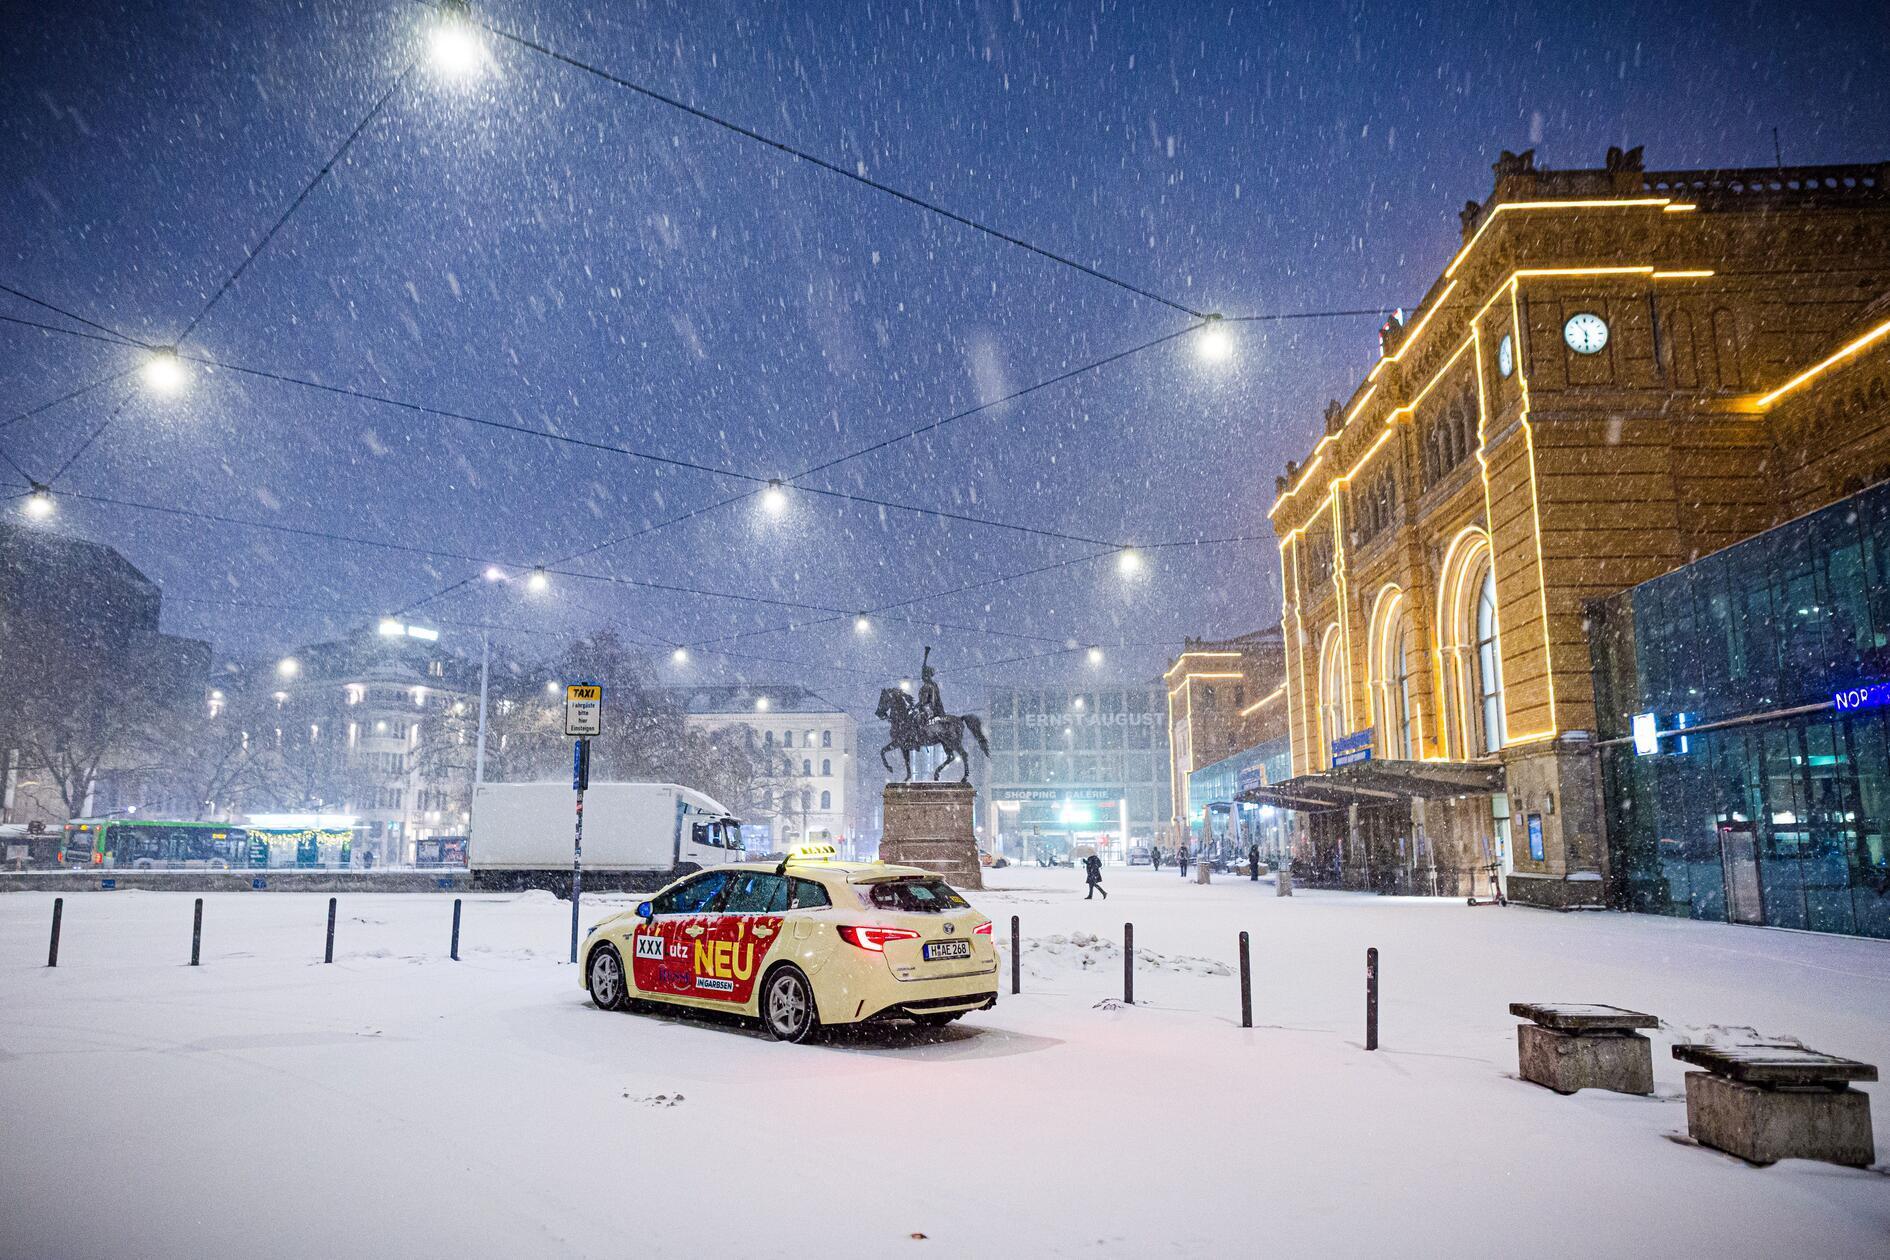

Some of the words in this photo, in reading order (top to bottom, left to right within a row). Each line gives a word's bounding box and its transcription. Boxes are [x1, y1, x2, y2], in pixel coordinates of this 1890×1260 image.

[573, 689, 595, 698] TAXI
[1025, 713, 1087, 727] ERNST
[1088, 712, 1165, 727] AUGUST
[1005, 791, 1057, 799] SHOPPING
[1065, 791, 1109, 799] GALERIE
[639, 939, 662, 955] XXX
[931, 945, 937, 957] H
[941, 945, 952, 956] AE
[953, 944, 967, 955] 268
[694, 939, 755, 980] NEU
[697, 979, 705, 987] IN
[705, 980, 733, 990] GARBSEN
